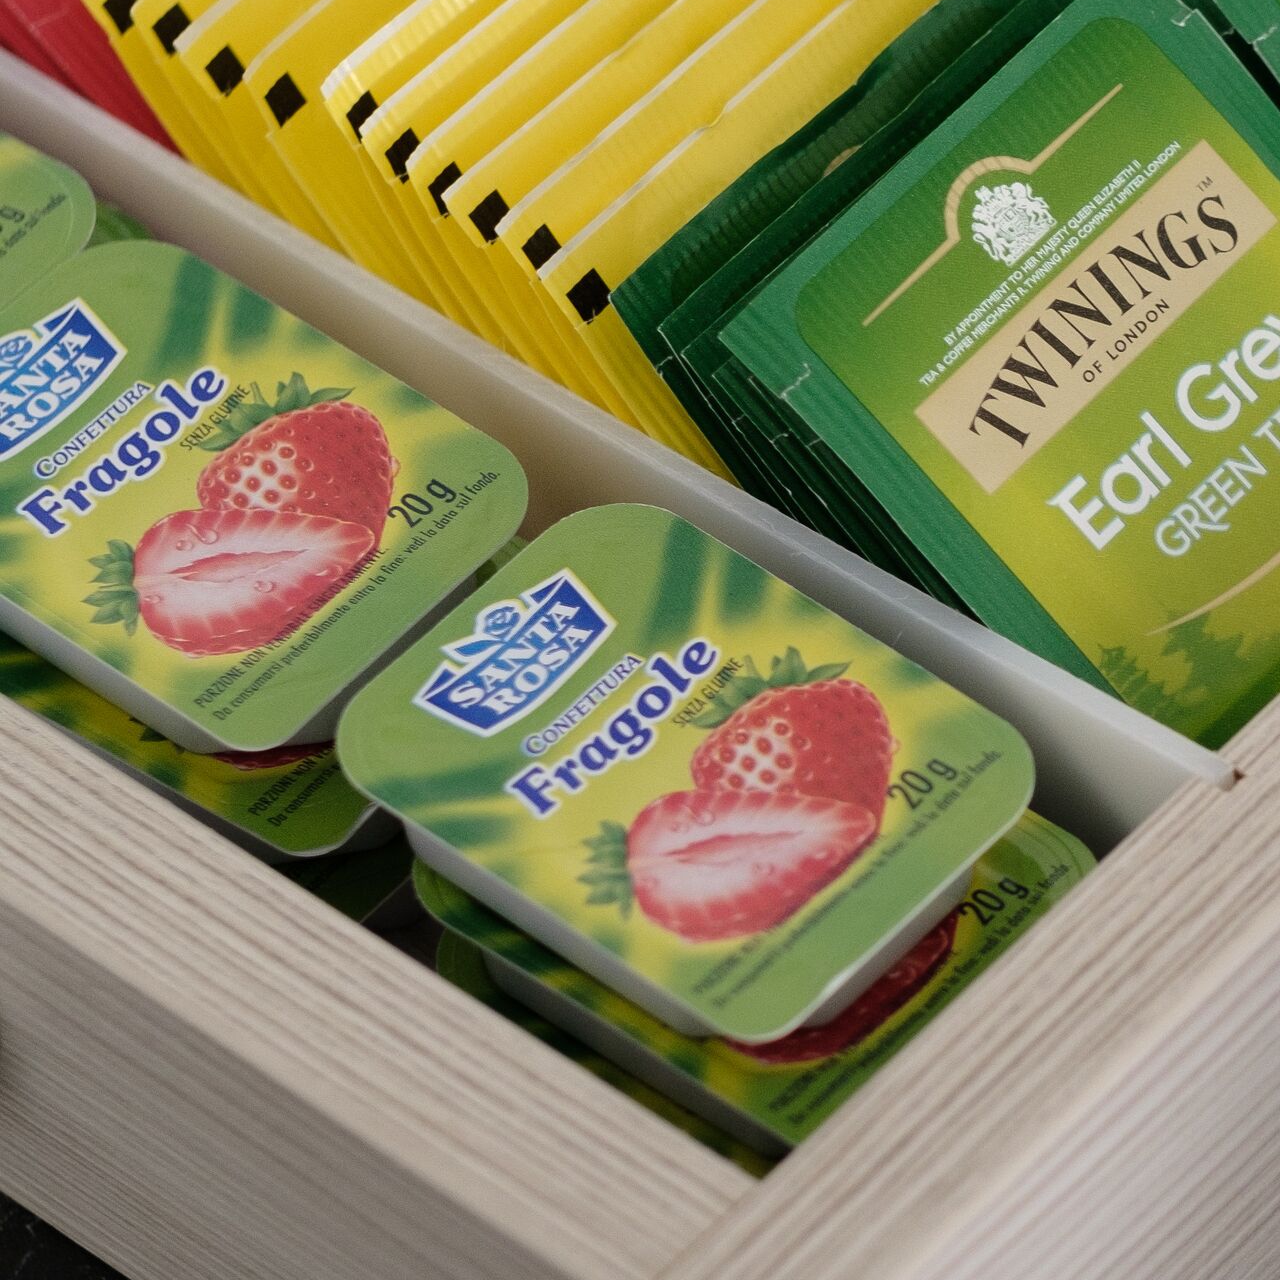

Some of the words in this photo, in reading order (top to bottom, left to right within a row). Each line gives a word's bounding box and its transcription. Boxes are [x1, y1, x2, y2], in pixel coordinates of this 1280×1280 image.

[919, 369, 940, 386] TEA
[936, 362, 946, 373] &
[943, 334, 975, 364] COFFEE
[970, 292, 1021, 339] MERCHANTS
[1023, 252, 1062, 289] TWINING
[1060, 236, 1080, 257] AND
[1077, 199, 1117, 238] COMPANY
[1143, 140, 1182, 177] LONDON
[943, 331, 958, 346] BY
[955, 280, 1011, 336] APPOINTMENT
[1007, 270, 1023, 284] TO
[1020, 255, 1040, 274] HER
[1035, 225, 1071, 260] MAJESTY
[1068, 200, 1097, 229] QUEEN
[1093, 164, 1137, 205] ELIZABETH
[1131, 159, 1142, 170] II
[969, 193, 1239, 449] TWININGS
[1082, 360, 1103, 384] OF
[1105, 298, 1170, 361] LONDON
[22, 369, 225, 535] Fragole
[35, 381, 152, 478] CONFETTURA
[179, 422, 215, 452] SENZA
[212, 384, 252, 426] GLUTINE
[387, 493, 434, 528] 20
[426, 478, 457, 503] g
[1046, 411, 1193, 552] Earl
[1155, 443, 1269, 558] GREEN
[231, 660, 285, 708] consumarsi
[404, 535, 427, 554] vedi
[455, 492, 473, 510] sul
[194, 663, 246, 709] PORZIONE
[240, 648, 269, 669] NON
[448, 601, 581, 709] SANTA
[480, 625, 595, 715] ROSA
[525, 654, 644, 755] CONFETTURA
[672, 697, 708, 728] SENZA
[701, 657, 744, 700] GLUTINE
[511, 640, 718, 815] Fragole
[886, 770, 933, 810] 20
[927, 758, 957, 780] g
[957, 888, 1006, 927] 20
[998, 877, 1030, 900] g
